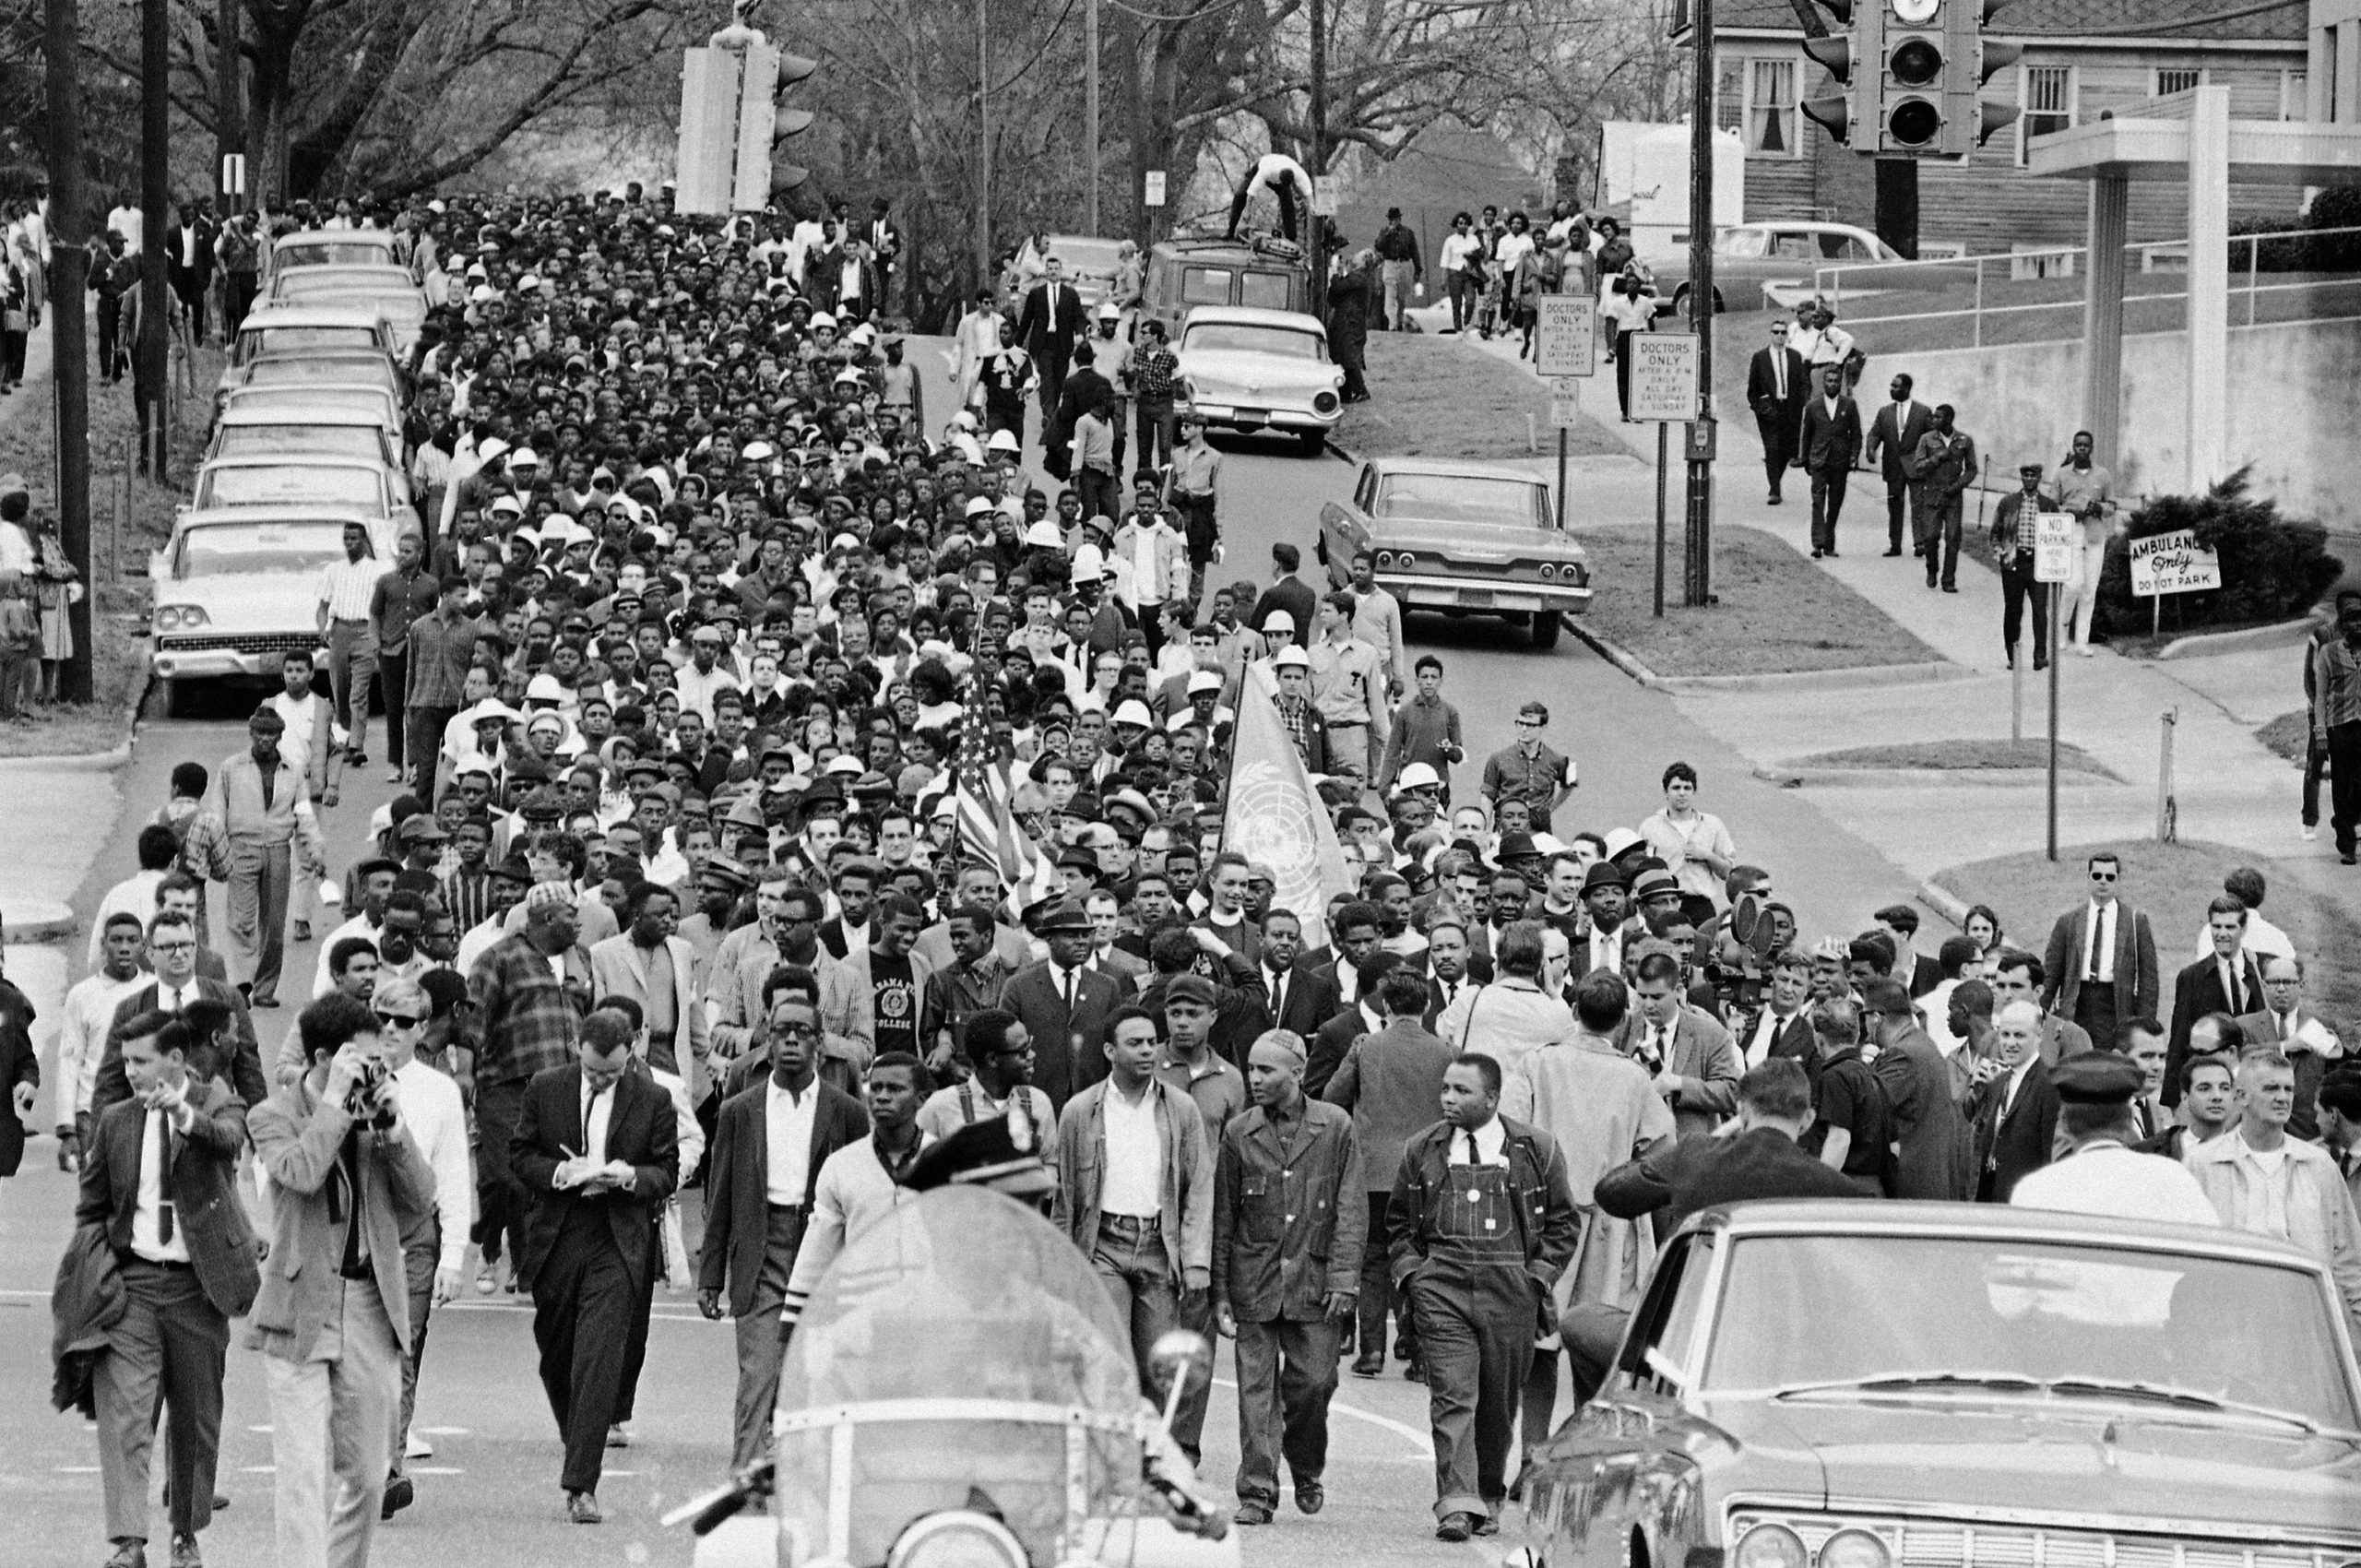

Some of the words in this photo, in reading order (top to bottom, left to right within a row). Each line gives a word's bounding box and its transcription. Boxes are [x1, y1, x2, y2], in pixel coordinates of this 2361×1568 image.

[1547, 303, 1587, 315] DOCTORS
[1553, 315, 1581, 325] ONLY
[1641, 343, 1690, 353] DOCTORS
[1649, 355, 1679, 365] ONLY
[1645, 385, 1660, 393] ALL
[1666, 385, 1683, 393] DAY
[1641, 393, 1686, 401] SATURDAY
[1651, 402, 1686, 411] SUNDAY
[2048, 518, 2062, 532] NO
[2039, 533, 2070, 546] PARKING
[2132, 536, 2200, 561] AMBULANC
[2152, 551, 2193, 575] Only
[2139, 580, 2151, 590] DO
[2178, 574, 2211, 586] PARK
